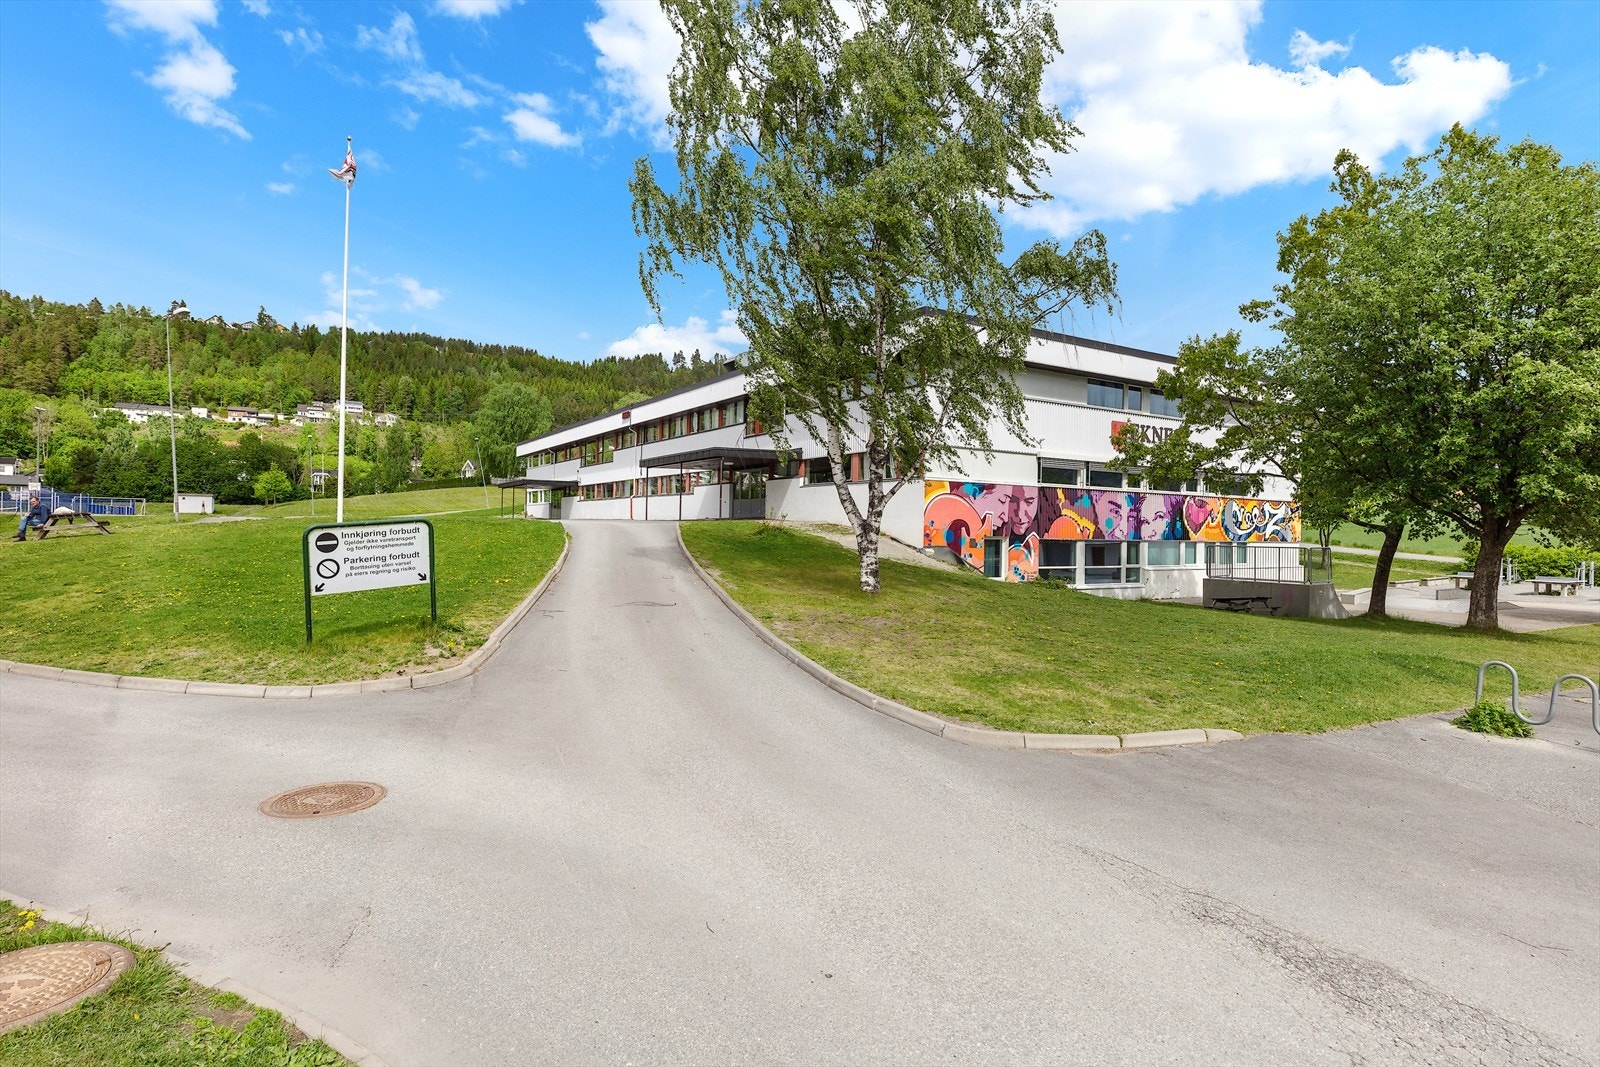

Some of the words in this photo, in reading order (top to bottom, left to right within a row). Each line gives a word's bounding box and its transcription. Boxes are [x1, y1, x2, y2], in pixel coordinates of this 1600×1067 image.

[341, 530, 387, 539] Innkjøring
[389, 527, 420, 535] forbudt
[344, 538, 365, 546] Gjelder
[355, 542, 414, 551] forflytningshemmede
[343, 555, 387, 564] Parkering
[389, 552, 420, 561] forbudt
[350, 563, 380, 571] Borttauing
